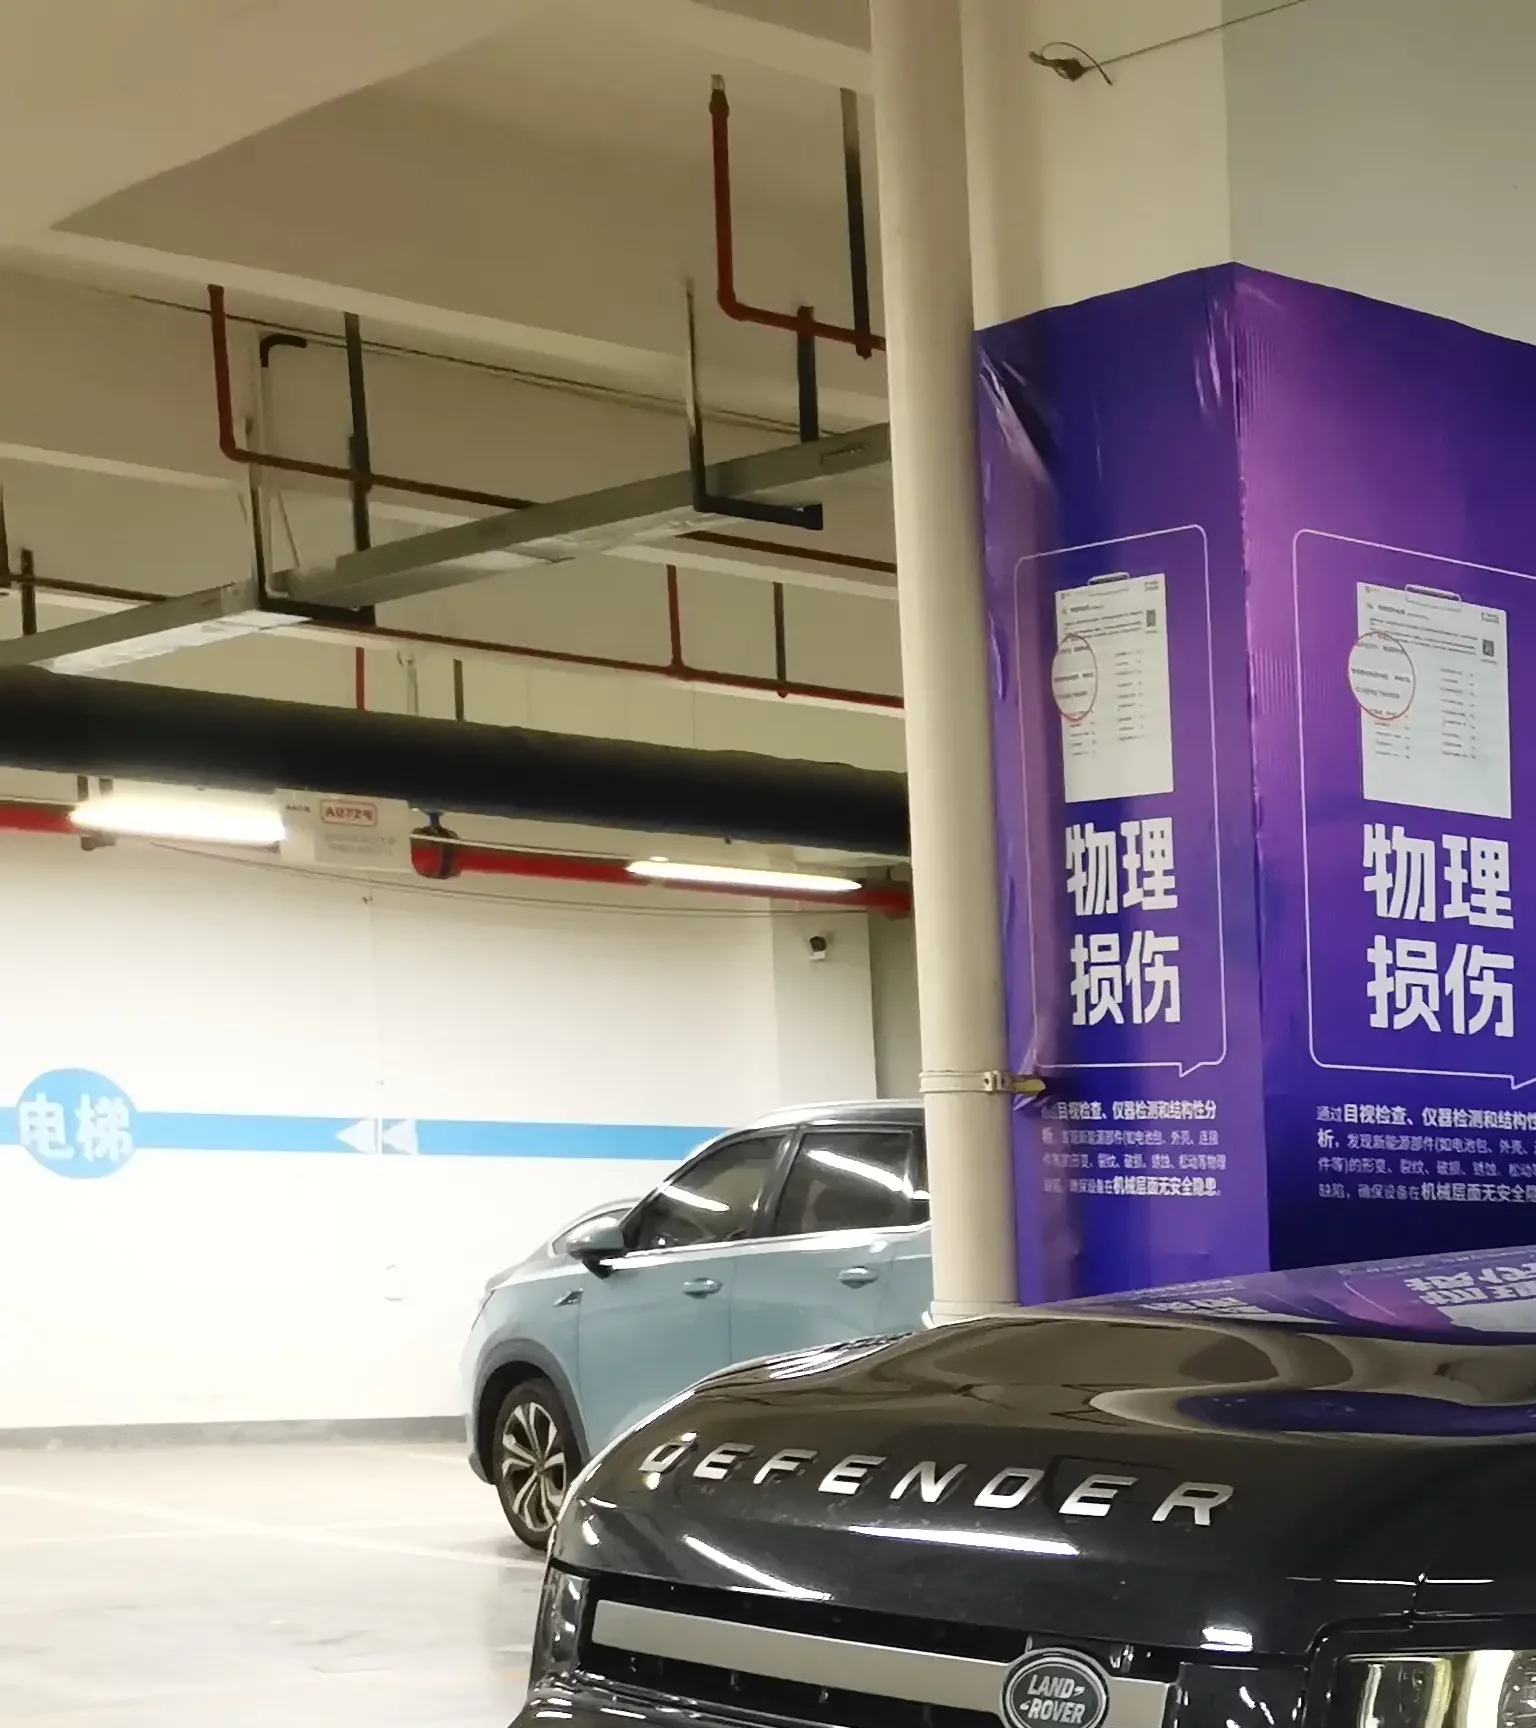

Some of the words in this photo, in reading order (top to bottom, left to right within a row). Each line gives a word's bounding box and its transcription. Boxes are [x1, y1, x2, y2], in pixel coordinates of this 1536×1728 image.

[1065, 817, 1178, 916] 物理
[1363, 823, 1514, 929] 物理
[1070, 930, 1181, 1026] 损伤
[1366, 934, 1515, 1038] 损伤
[18, 1092, 134, 1162] 电梯
[640, 1432, 1236, 1527] DEFENDER
[1027, 1674, 1075, 1700] LAND
[1027, 1698, 1086, 1725] ROVER
